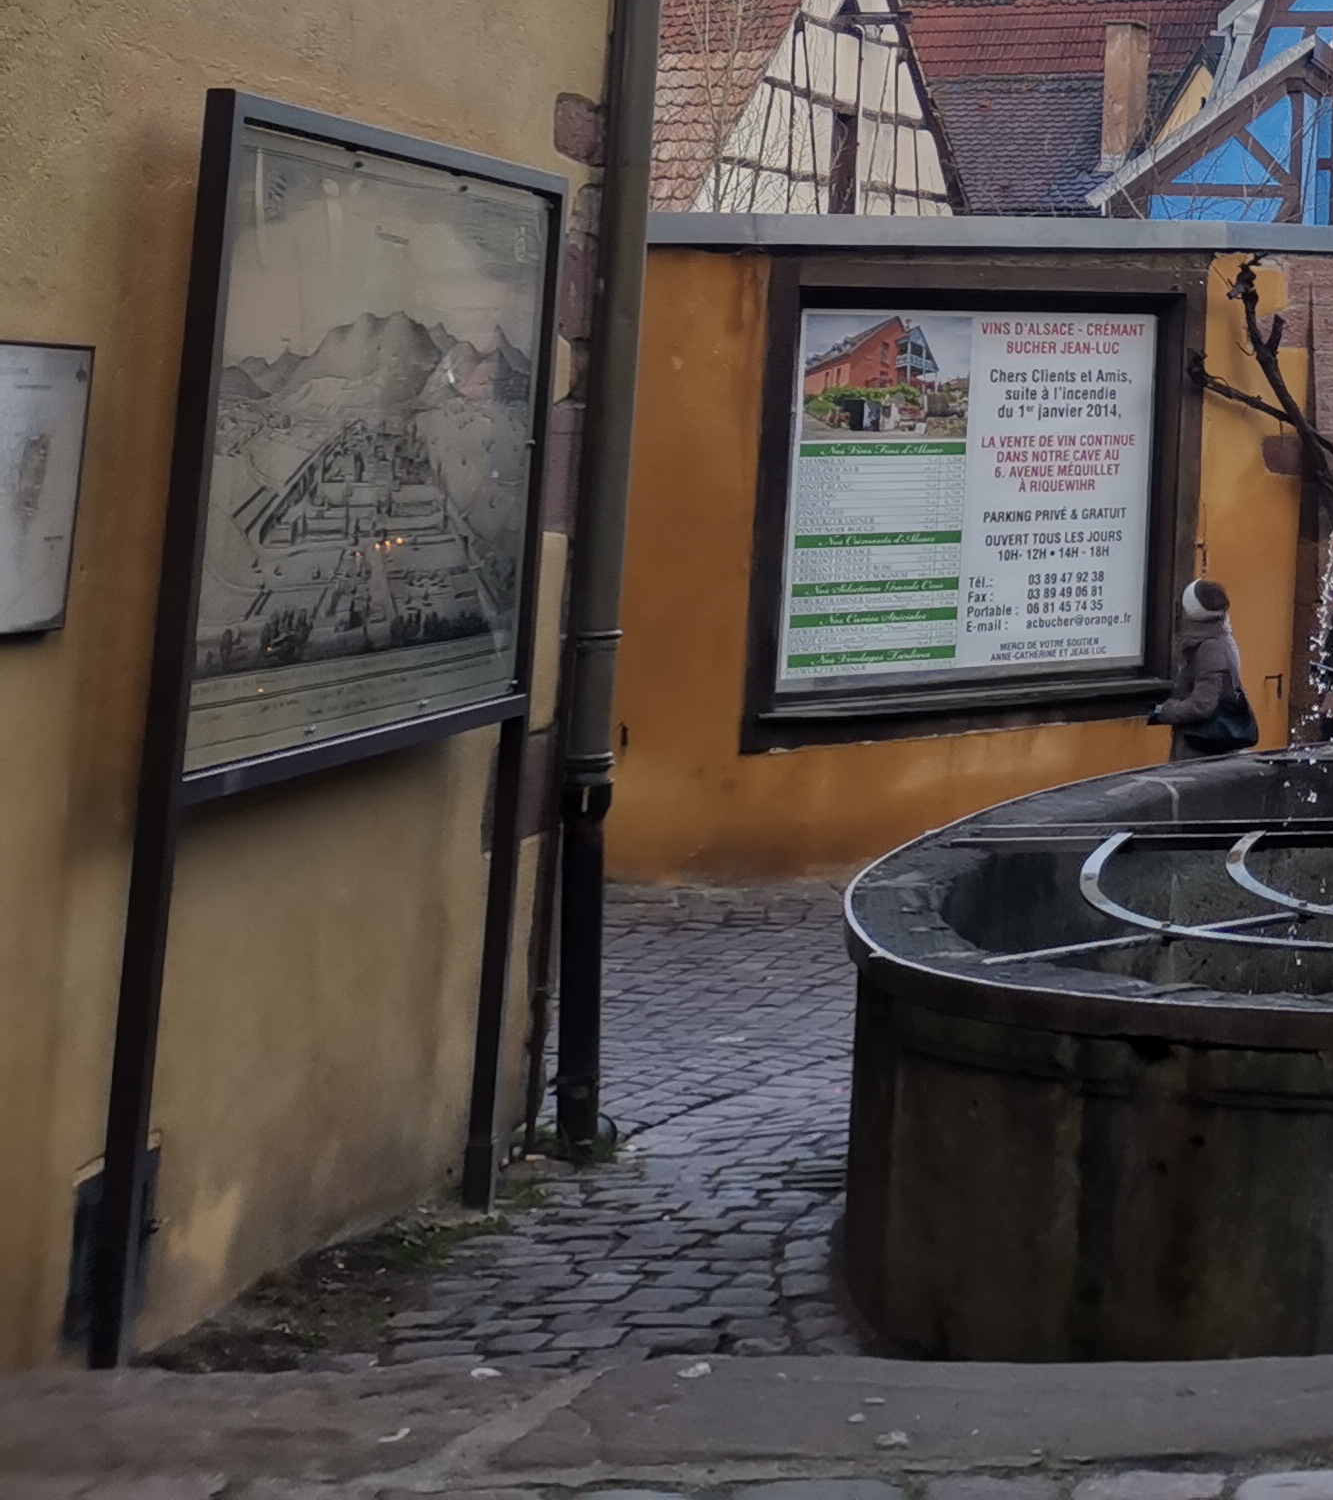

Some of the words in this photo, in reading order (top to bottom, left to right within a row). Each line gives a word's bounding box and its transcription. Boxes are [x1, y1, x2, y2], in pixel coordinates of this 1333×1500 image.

[981, 322, 1011, 335] VINS
[1015, 323, 1075, 335] D'ALSACE
[1087, 322, 1145, 336] CRÉMANT
[1007, 341, 1056, 354] BUCHER
[1060, 342, 1119, 354] JEAN-LUC
[990, 369, 1027, 383] Chers
[1032, 369, 1076, 382] Clients
[1081, 370, 1092, 382] et
[1095, 369, 1132, 384] Amis,
[1005, 388, 1036, 400] suite
[1041, 386, 1049, 400] à
[1054, 387, 1117, 400] l'incendie
[998, 404, 1013, 418] du
[1037, 404, 1083, 421] janvier
[1086, 404, 1122, 420] 2014,
[981, 436, 995, 448] LA
[1000, 435, 1035, 448] VENTE
[1039, 435, 1055, 447] DE
[1057, 435, 1076, 447] VIN
[1080, 434, 1135, 446] CONTINUE
[997, 451, 1028, 463] DANS
[1032, 450, 1069, 462] NOTRE
[1073, 449, 1100, 461] CAVE
[1104, 449, 1119, 461] AU
[1009, 465, 1054, 478] AVENUE
[1057, 461, 1120, 476] MÉQUILLET
[1018, 478, 1026, 492] À
[1030, 479, 1095, 492] RIQUEWIHR
[983, 511, 1032, 523] PARKING
[1035, 506, 1067, 521] PRIVÉ
[1070, 509, 1078, 520] &
[1082, 507, 1127, 519] GRATUIT
[985, 534, 1029, 547] OUVERT
[1033, 532, 1061, 545] TOUS
[1064, 531, 1084, 543] LES
[1087, 530, 1122, 542] JOURS
[1027, 548, 1047, 560] 12H
[1059, 547, 1079, 558] 14H
[1090, 546, 1110, 557] 18H
[1028, 574, 1041, 585] 03
[1044, 573, 1057, 585] 89
[1060, 572, 1073, 583] 47
[1076, 572, 1088, 582] 92
[1091, 571, 1104, 582] 38
[968, 591, 986, 603] Fax
[1027, 588, 1040, 600] 03
[1043, 588, 1056, 599] 89
[1059, 587, 1072, 598] 49
[1075, 586, 1088, 597] 06
[1091, 585, 1103, 596] 81
[966, 605, 1012, 618] Portable
[1042, 602, 1055, 613] 81
[1059, 601, 1072, 612] 45
[1075, 600, 1087, 611] 74
[1090, 600, 1103, 611] 35
[966, 619, 1001, 632] E-mail
[1026, 612, 1132, 629] acbucher@orange.fr
[1027, 640, 1038, 650] DE
[1040, 639, 1064, 649] VOTRE
[1068, 637, 1099, 647] SOUTIEN
[1059, 648, 1068, 657] ET
